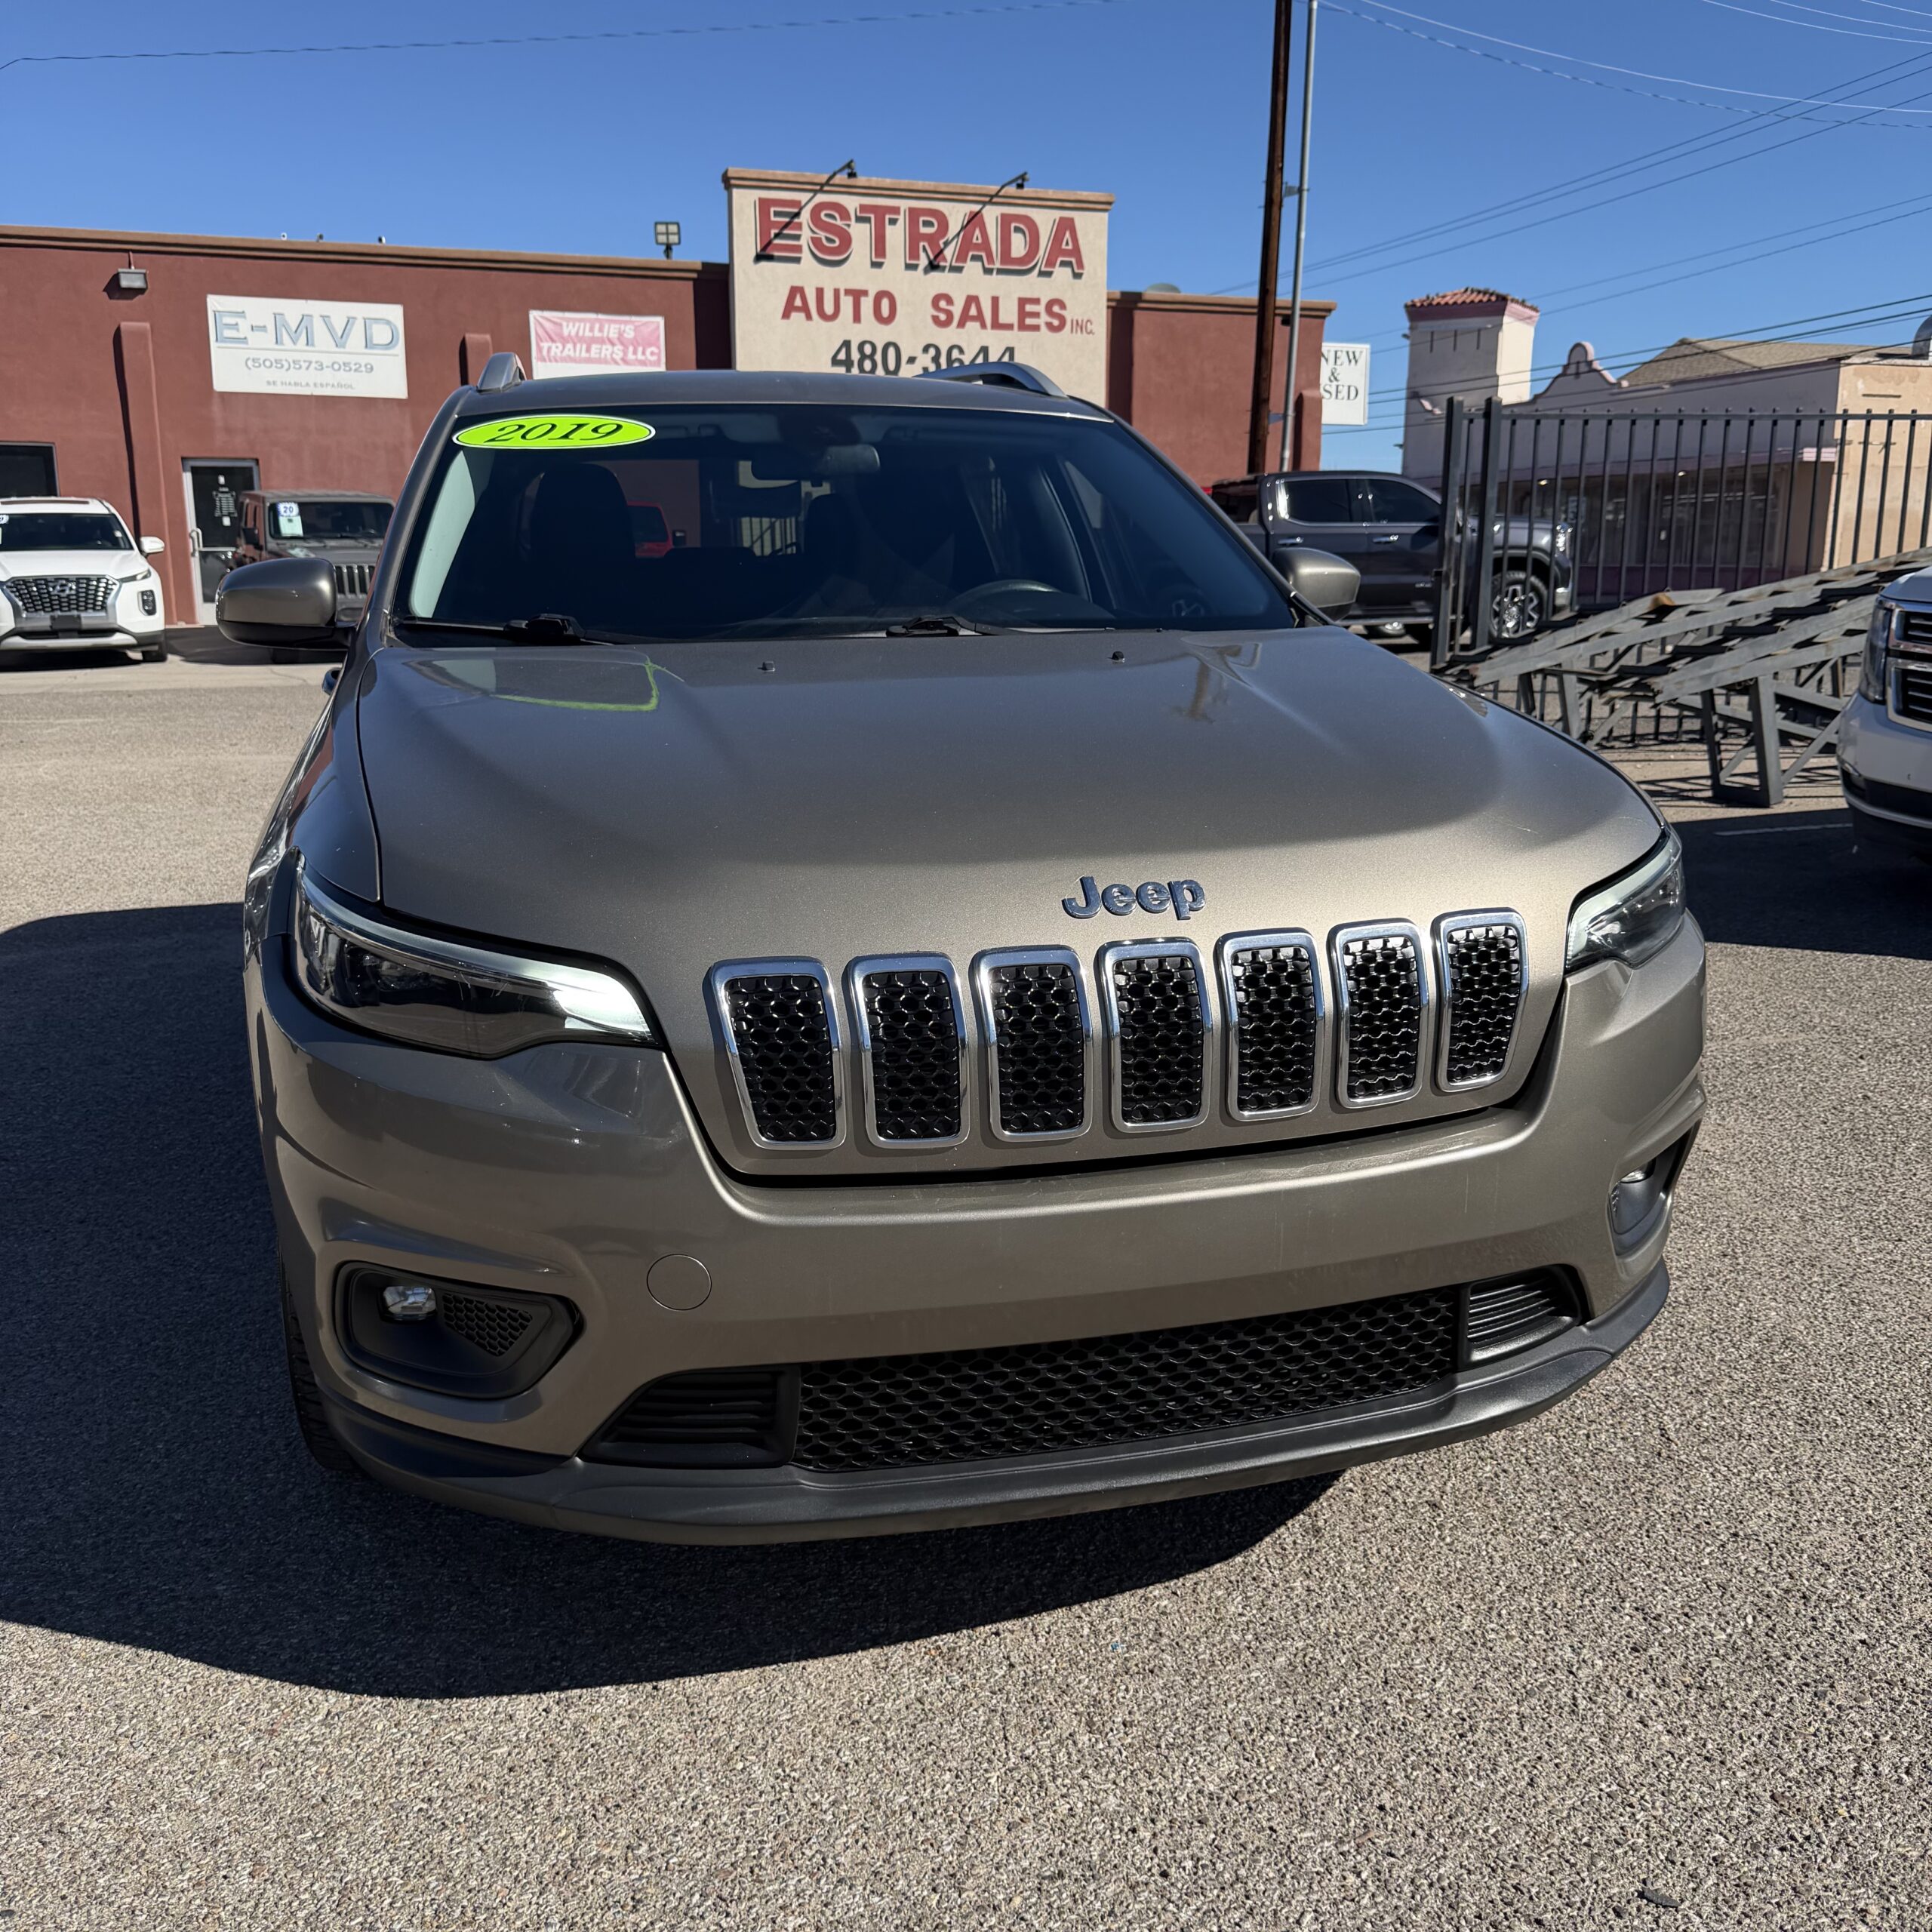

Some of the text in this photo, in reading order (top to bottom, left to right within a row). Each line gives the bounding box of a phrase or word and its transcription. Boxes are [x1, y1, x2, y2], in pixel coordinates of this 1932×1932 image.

[755, 197, 1086, 278] ESTRADA
[781, 285, 1095, 336] AUTO SALES INC.
[213, 310, 400, 351] E-MVD
[561, 321, 635, 339] WILLIE'S
[540, 342, 659, 361] TRAILERS LLC
[245, 356, 374, 374] (505)573-0529
[1328, 367, 1340, 383] &
[1321, 383, 1358, 401] SED
[484, 423, 623, 443] 2019
[1061, 875, 1207, 921] Jeep
